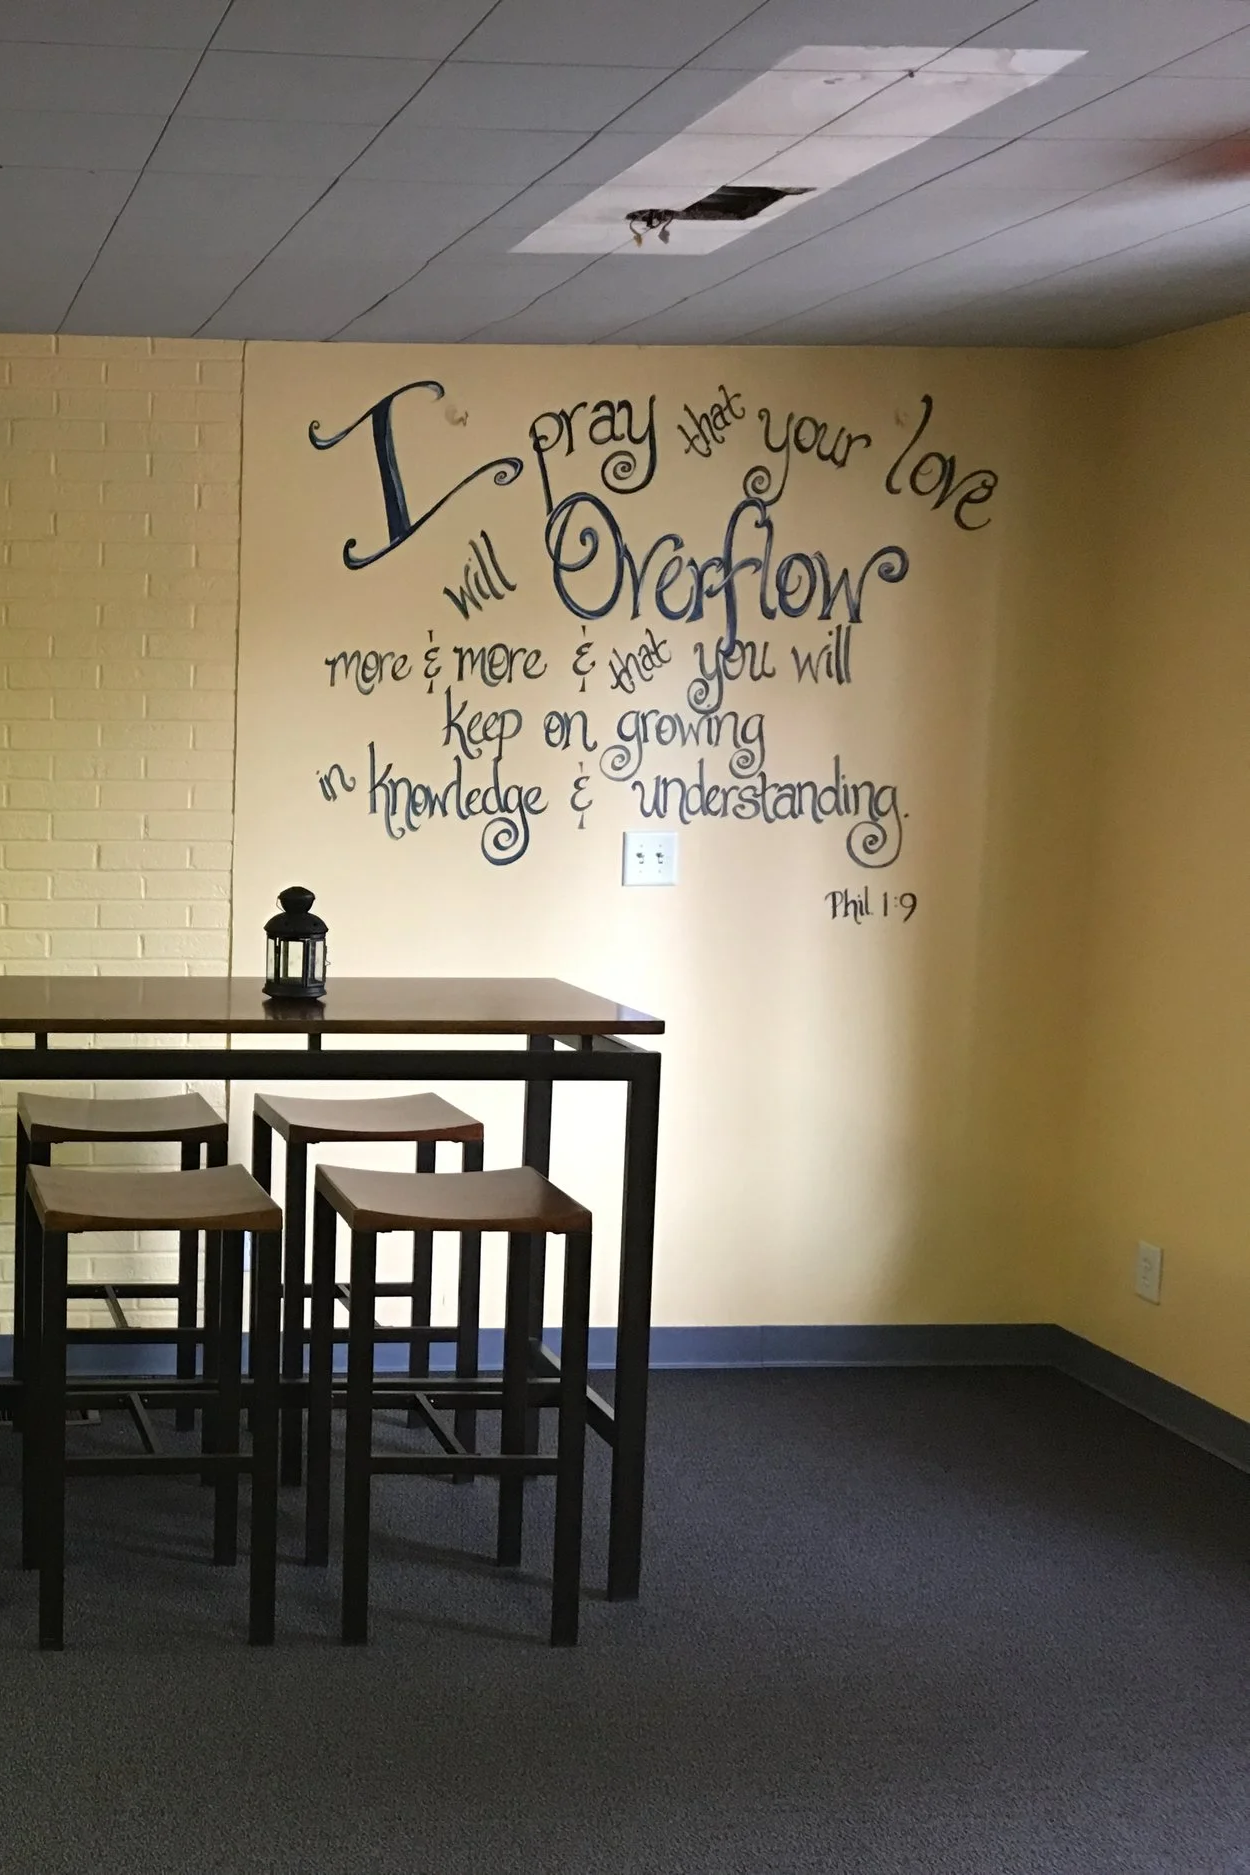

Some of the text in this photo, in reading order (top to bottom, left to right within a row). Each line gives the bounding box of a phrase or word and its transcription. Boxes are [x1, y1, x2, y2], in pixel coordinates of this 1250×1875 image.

[308, 380, 998, 571] I pray that your love
[442, 491, 909, 660] will Overflow
[324, 649, 412, 695] more
[453, 643, 548, 687] more
[608, 628, 672, 694] that
[687, 634, 776, 715] you
[791, 624, 853, 686] will
[316, 763, 357, 802] in
[543, 710, 598, 751] on
[600, 709, 766, 782] growing
